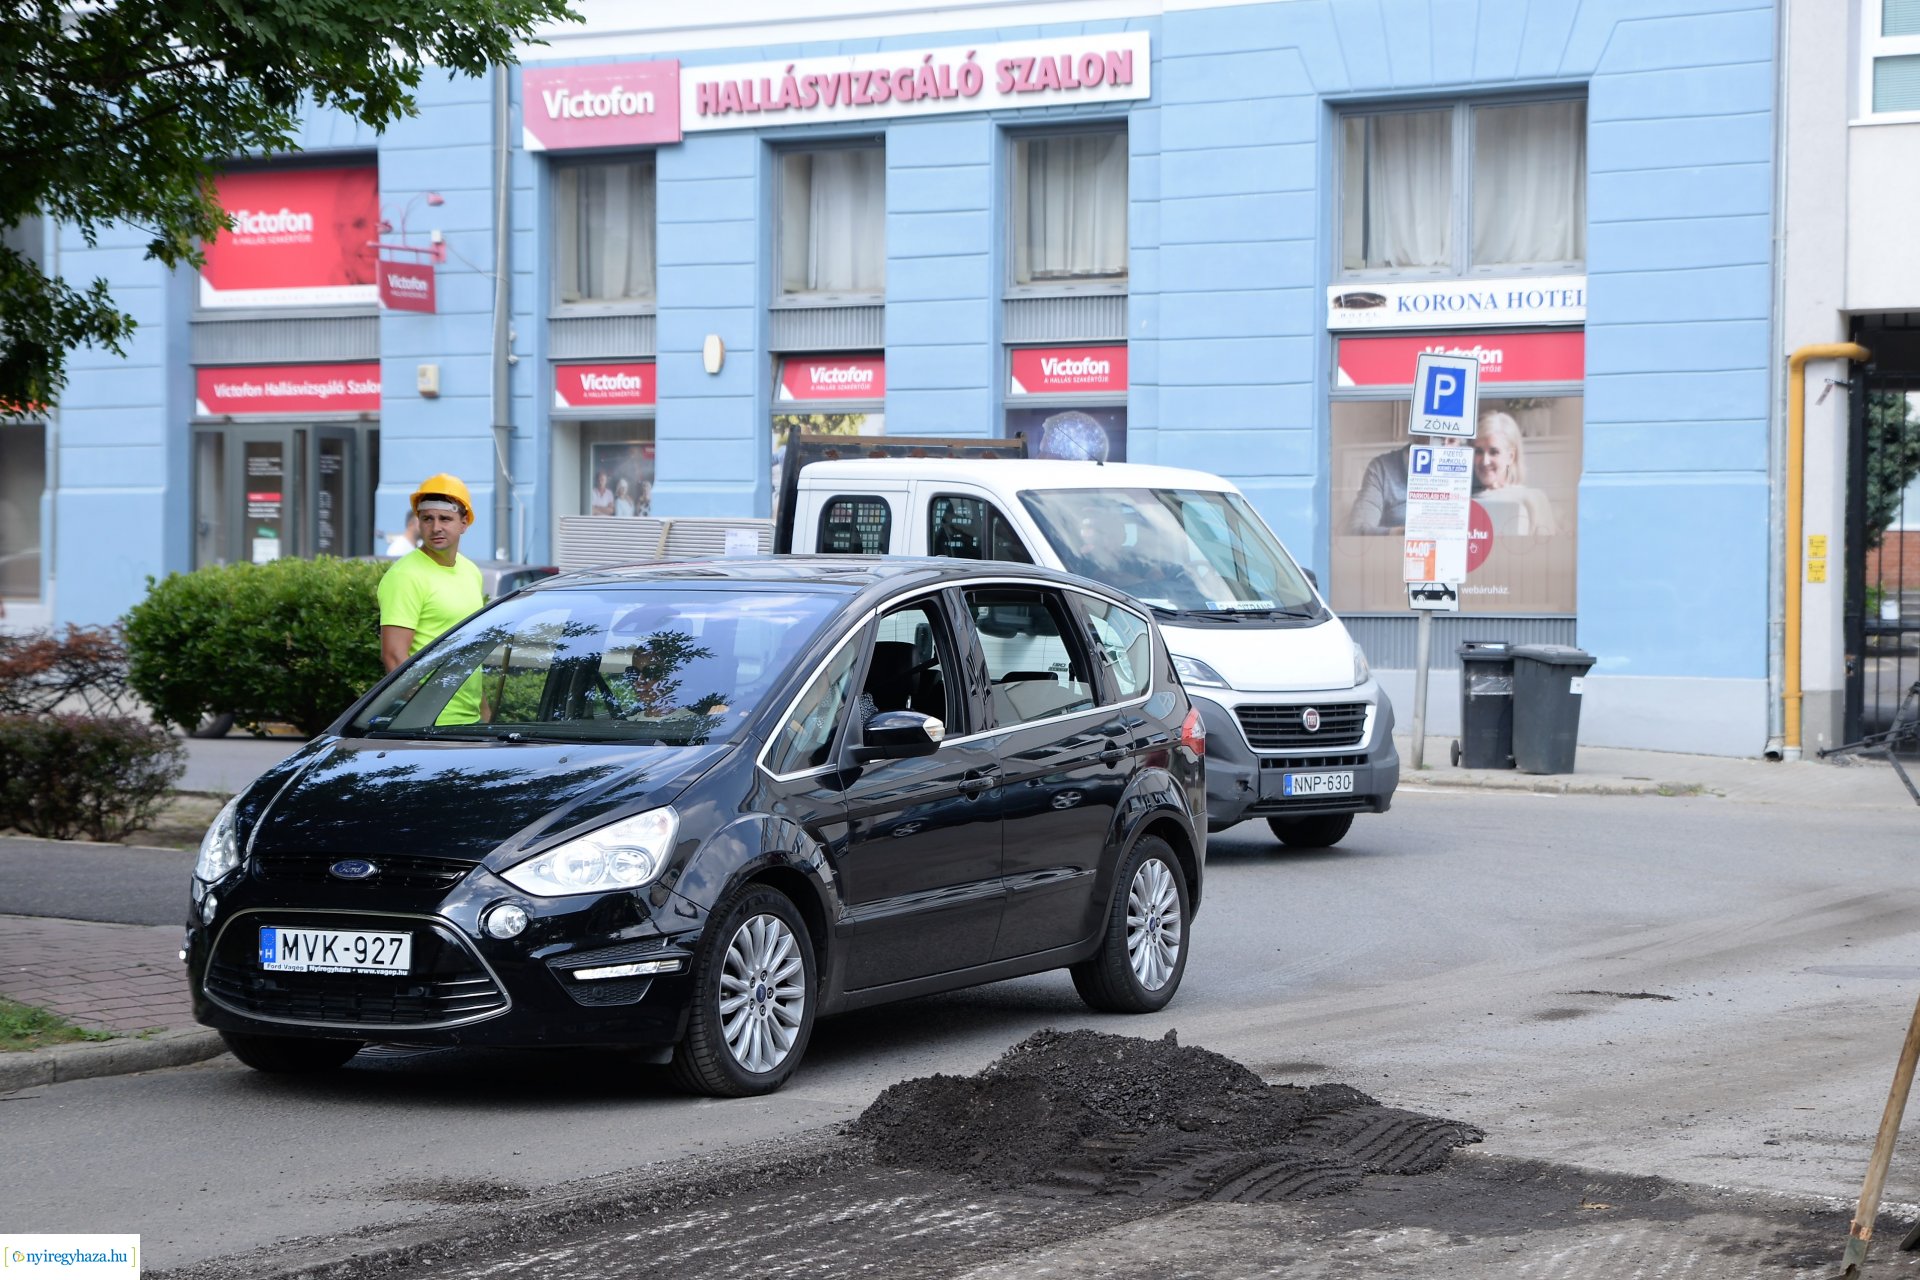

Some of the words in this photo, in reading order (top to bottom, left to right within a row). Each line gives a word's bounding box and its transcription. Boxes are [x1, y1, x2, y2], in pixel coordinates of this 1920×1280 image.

[696, 50, 984, 116] HALLÁSVIZSGÁLÓ
[996, 49, 1133, 94] SZALON
[542, 86, 655, 119] Victofon
[387, 273, 428, 291] Victofon
[1397, 292, 1498, 313] KORONA
[810, 365, 873, 384] Victofon
[1041, 356, 1110, 376] Victofon
[213, 382, 262, 398] Victofon
[580, 372, 642, 391] Victofon
[1433, 374, 1457, 410] P
[1423, 418, 1461, 431] ZÓNA
[1416, 450, 1431, 472] P
[1294, 774, 1351, 793] NNP-630
[338, 863, 364, 874] Ford
[265, 949, 273, 959] H
[282, 933, 403, 966] MVK-927
